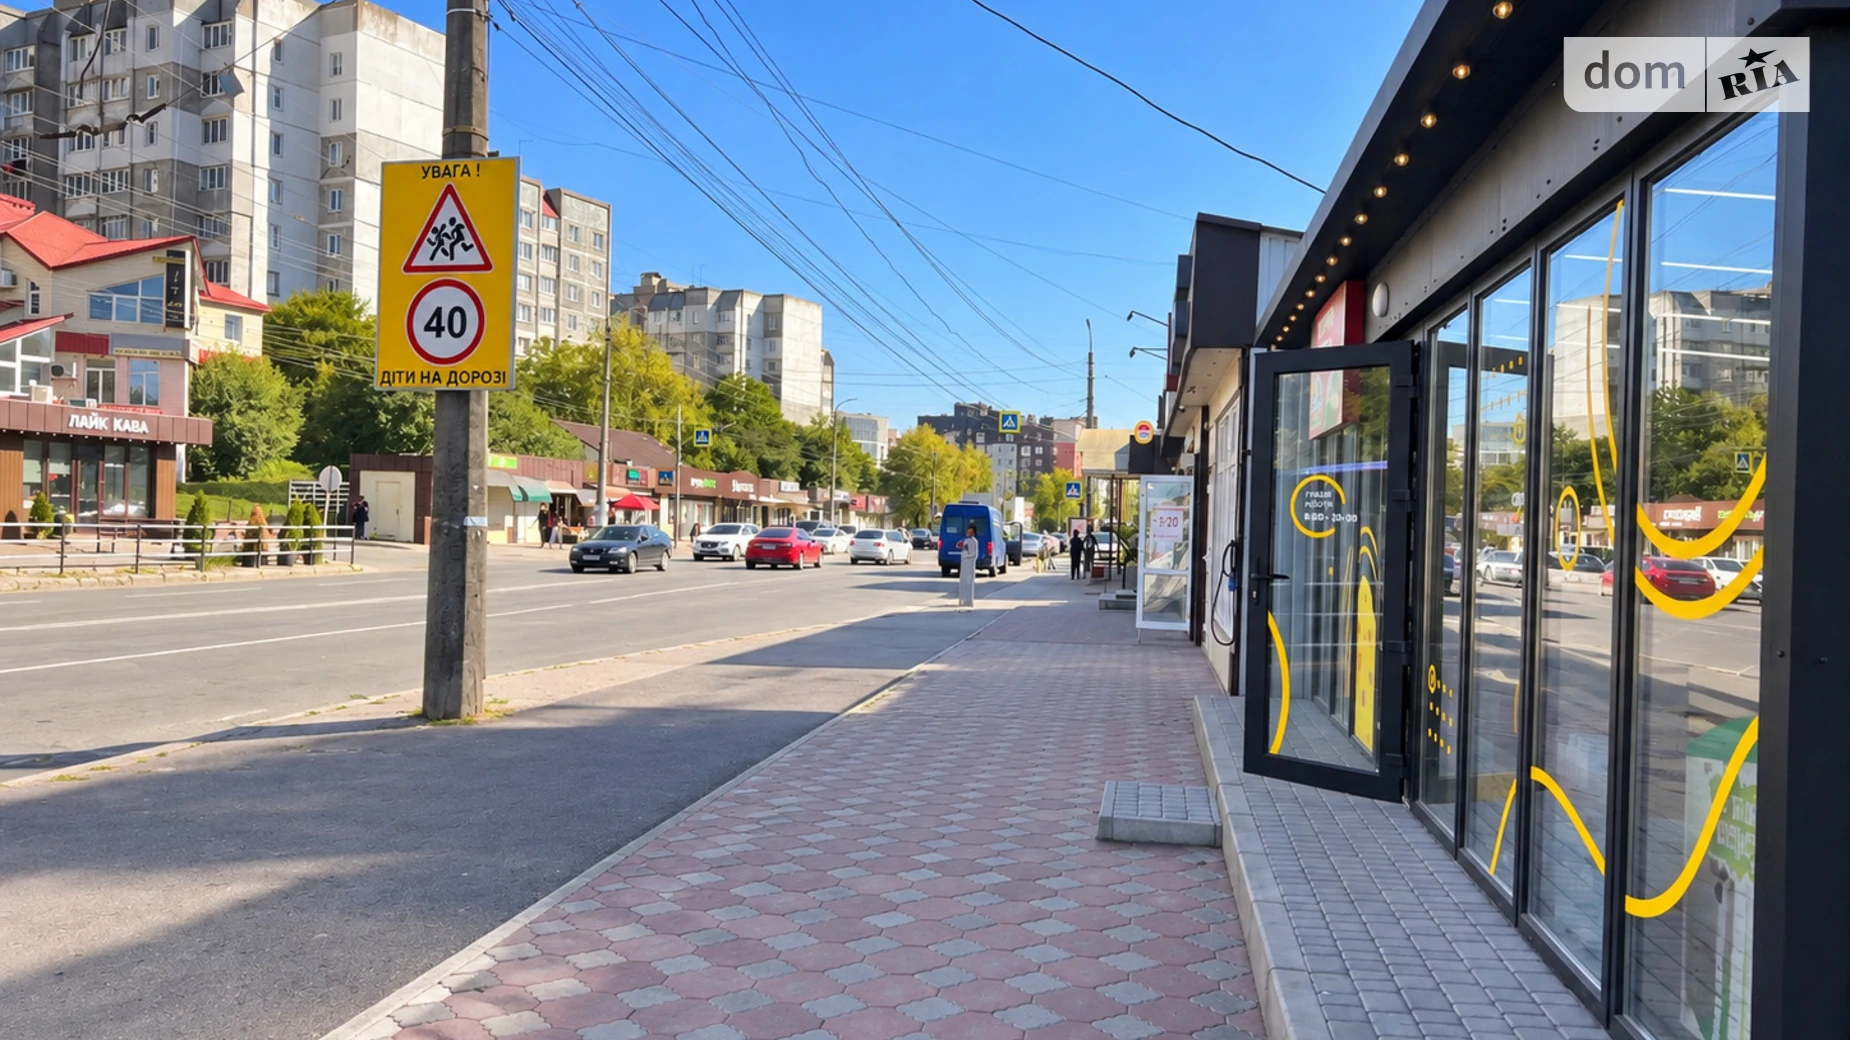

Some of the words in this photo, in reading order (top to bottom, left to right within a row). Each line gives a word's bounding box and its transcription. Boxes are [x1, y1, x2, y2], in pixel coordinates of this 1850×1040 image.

[421, 163, 471, 179] УВАГА
[423, 305, 468, 339] 40
[380, 370, 416, 387] ДІТИ
[420, 370, 442, 385] НА
[446, 370, 507, 388] ДОРОЗІ
[68, 412, 109, 431] ЛАЙК
[113, 416, 149, 434] КАВА
